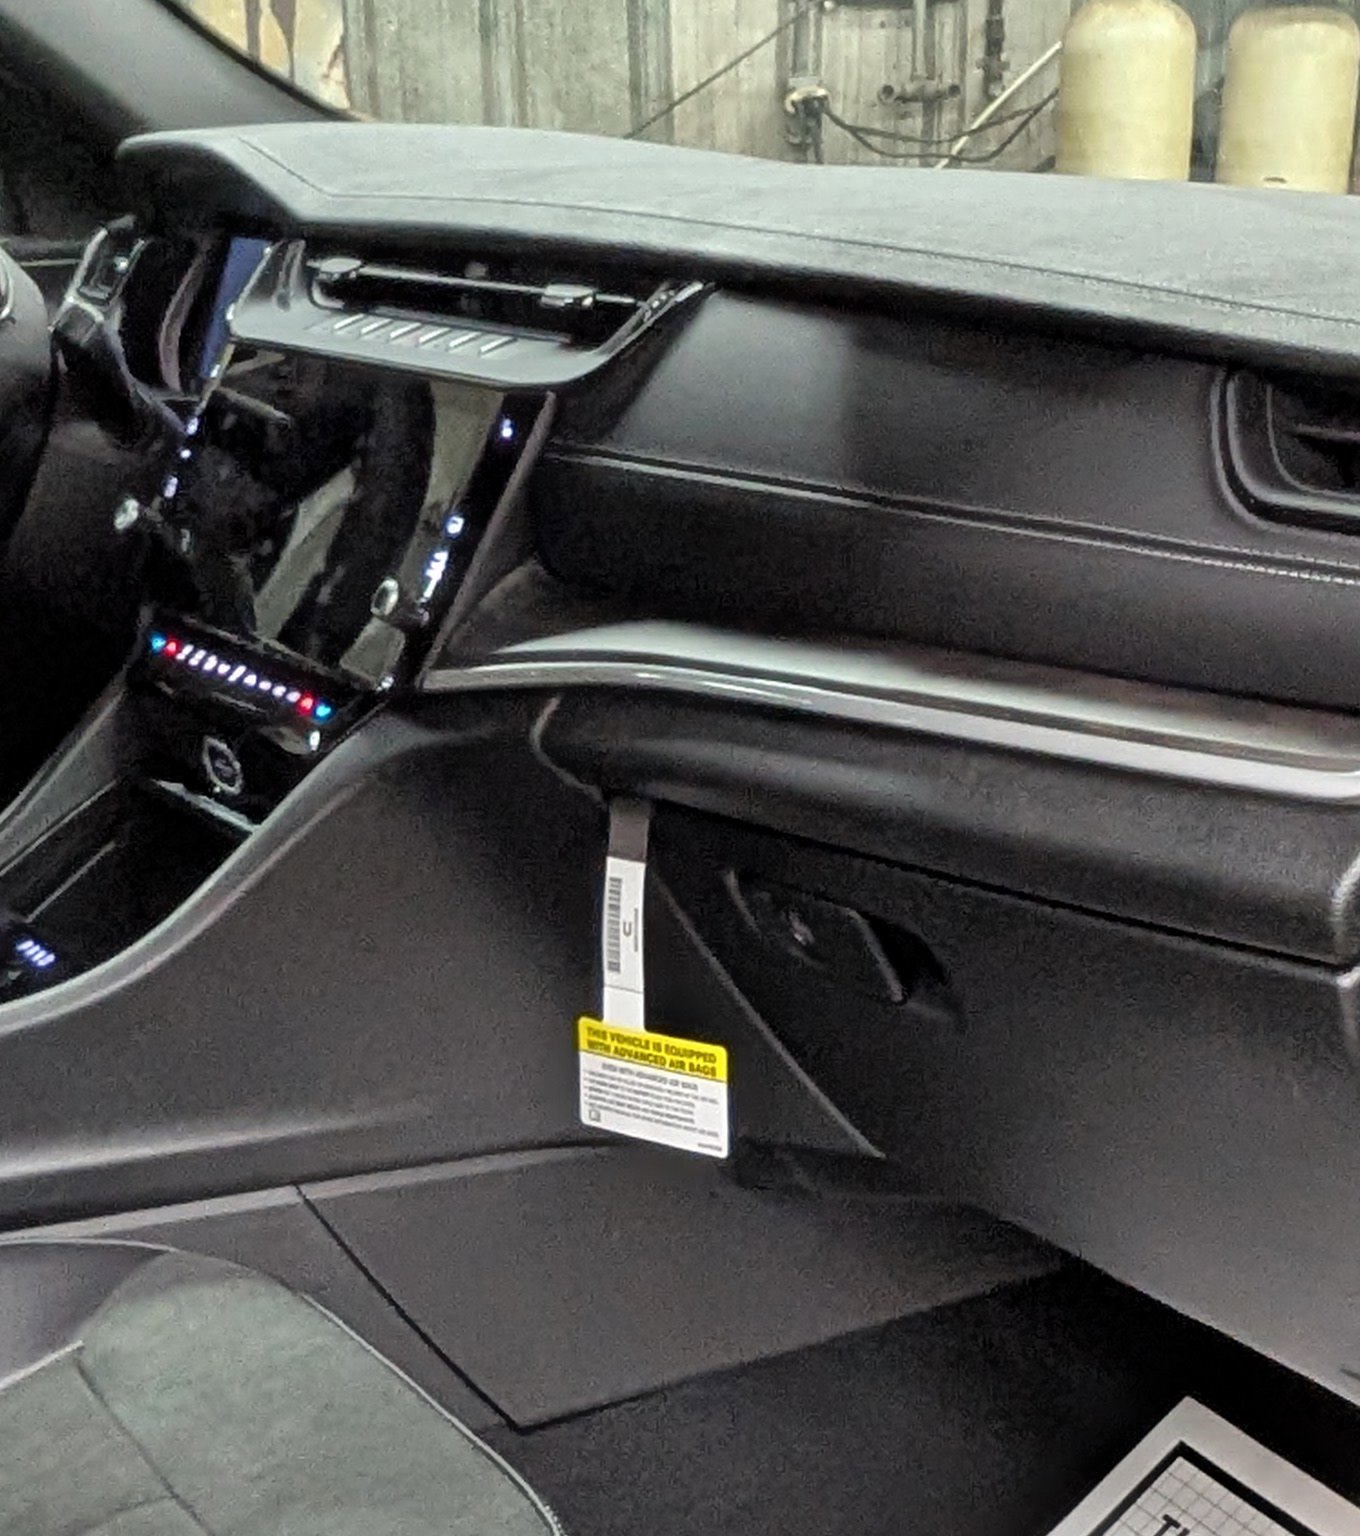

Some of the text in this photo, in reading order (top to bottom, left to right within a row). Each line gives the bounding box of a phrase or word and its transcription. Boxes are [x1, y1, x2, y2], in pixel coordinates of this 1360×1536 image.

[587, 1027, 716, 1063] THIS VEHICLE IS EQUIPPED
[587, 1039, 716, 1076] WITH ADVANCED AIR BAGS
